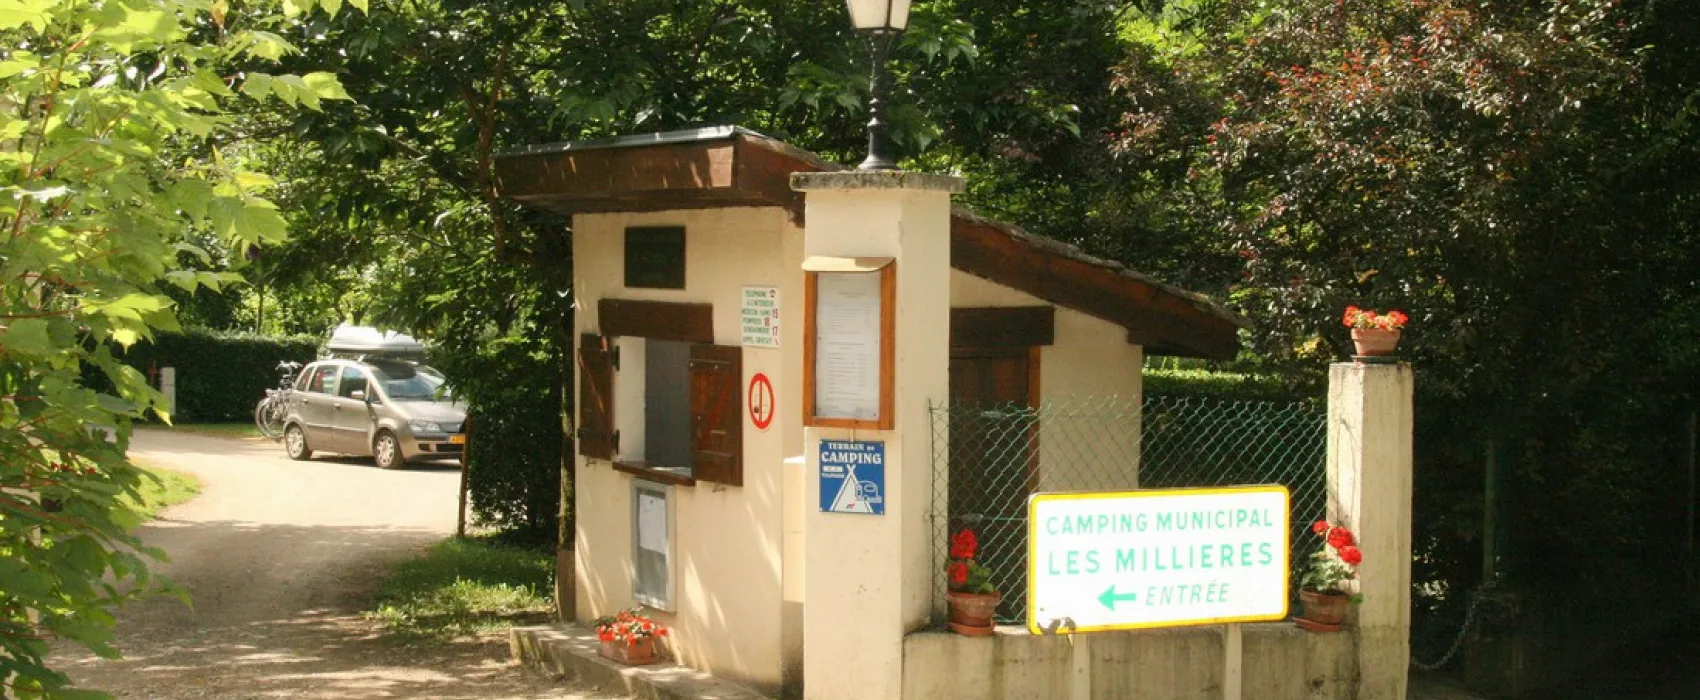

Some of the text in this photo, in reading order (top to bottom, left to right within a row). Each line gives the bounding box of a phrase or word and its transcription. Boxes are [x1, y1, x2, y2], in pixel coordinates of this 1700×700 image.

[772, 308, 779, 319] 15
[772, 326, 778, 336] 17
[828, 442, 864, 450] TERRAIN
[821, 451, 882, 464] CAMPING
[1046, 508, 1273, 535] CAMPING MUNICIPAL
[1048, 542, 1273, 575] LES MILLIERES
[1145, 579, 1230, 606] ENTRÉE
